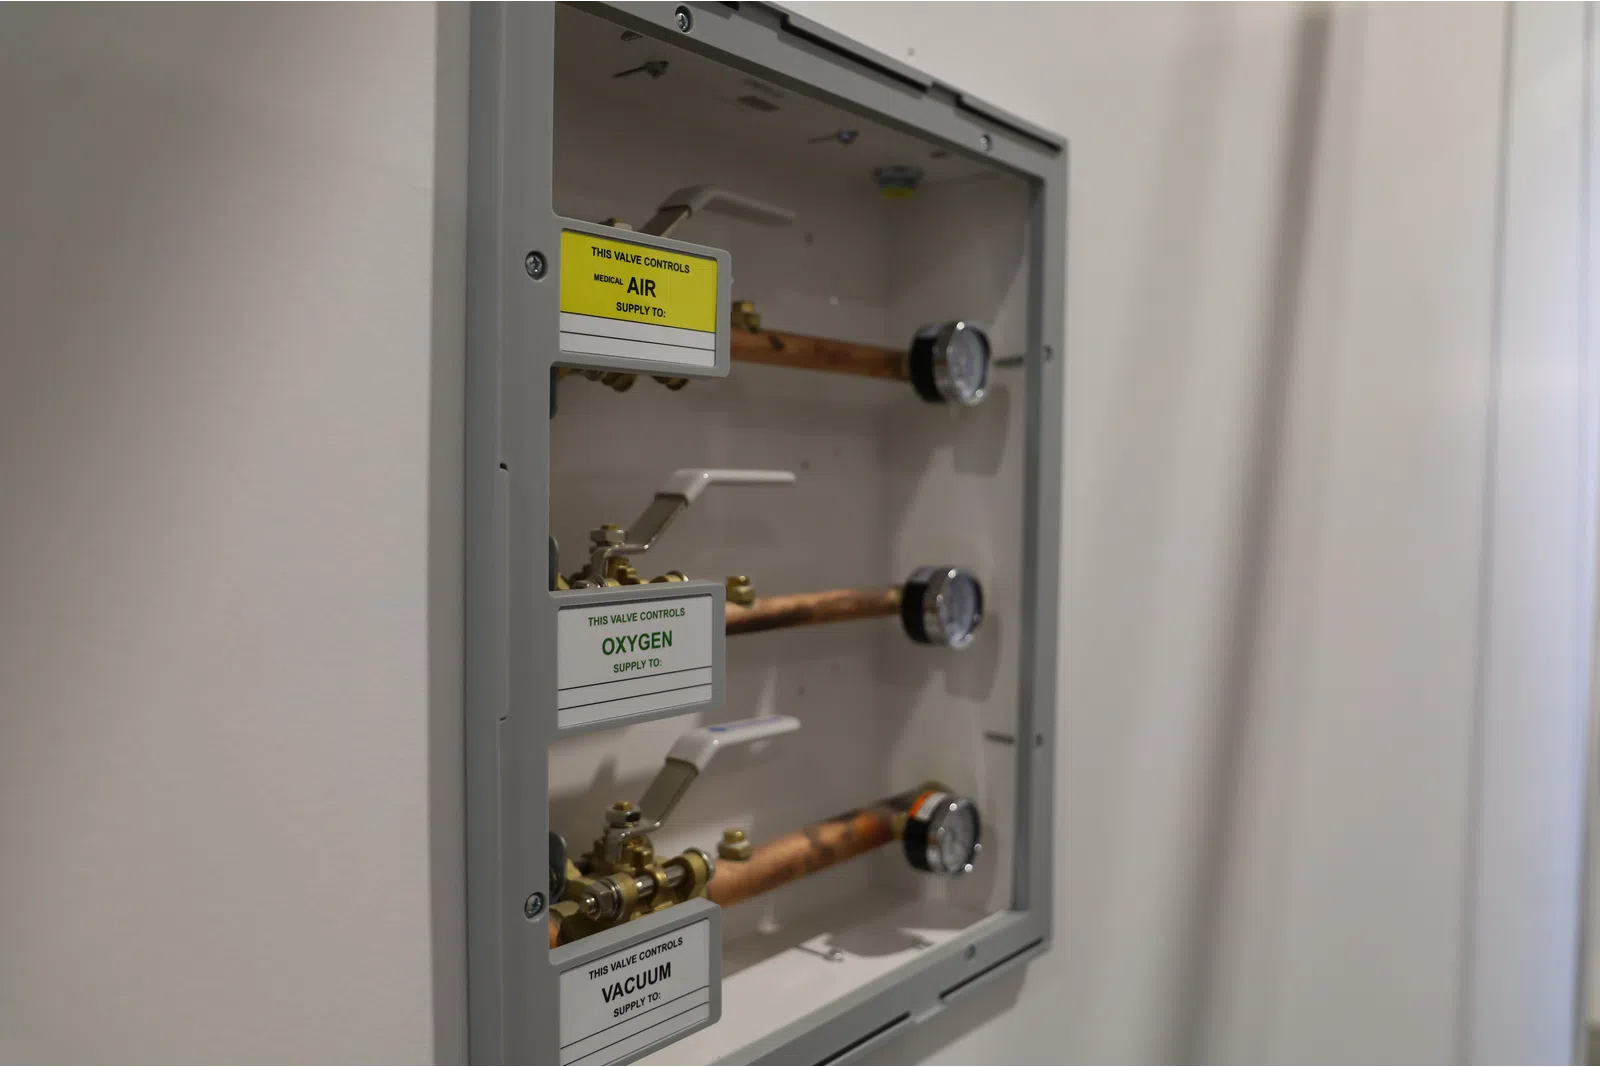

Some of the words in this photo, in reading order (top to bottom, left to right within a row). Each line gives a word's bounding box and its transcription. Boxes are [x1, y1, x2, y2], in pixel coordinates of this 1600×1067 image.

[591, 246, 612, 259] THIS
[613, 250, 642, 265] VALVE
[644, 257, 690, 274] CONTROLS
[593, 273, 624, 286] MEDICAL
[627, 276, 656, 298] AIR
[616, 301, 650, 315] SUPPLY
[653, 307, 666, 318] TO:
[588, 616, 608, 626] THIS
[610, 613, 638, 624] VALVE
[640, 607, 685, 621] CONTROLS
[602, 630, 673, 655] OXYGEN
[613, 660, 646, 673] SUPPLY
[648, 658, 662, 668] TO:
[588, 966, 608, 980] THIS
[610, 955, 637, 971] VALVE
[639, 937, 683, 961] CONTROLS
[601, 961, 672, 1003] VACUUM
[613, 997, 646, 1017] SUPPLY
[648, 991, 661, 1003] TO:
